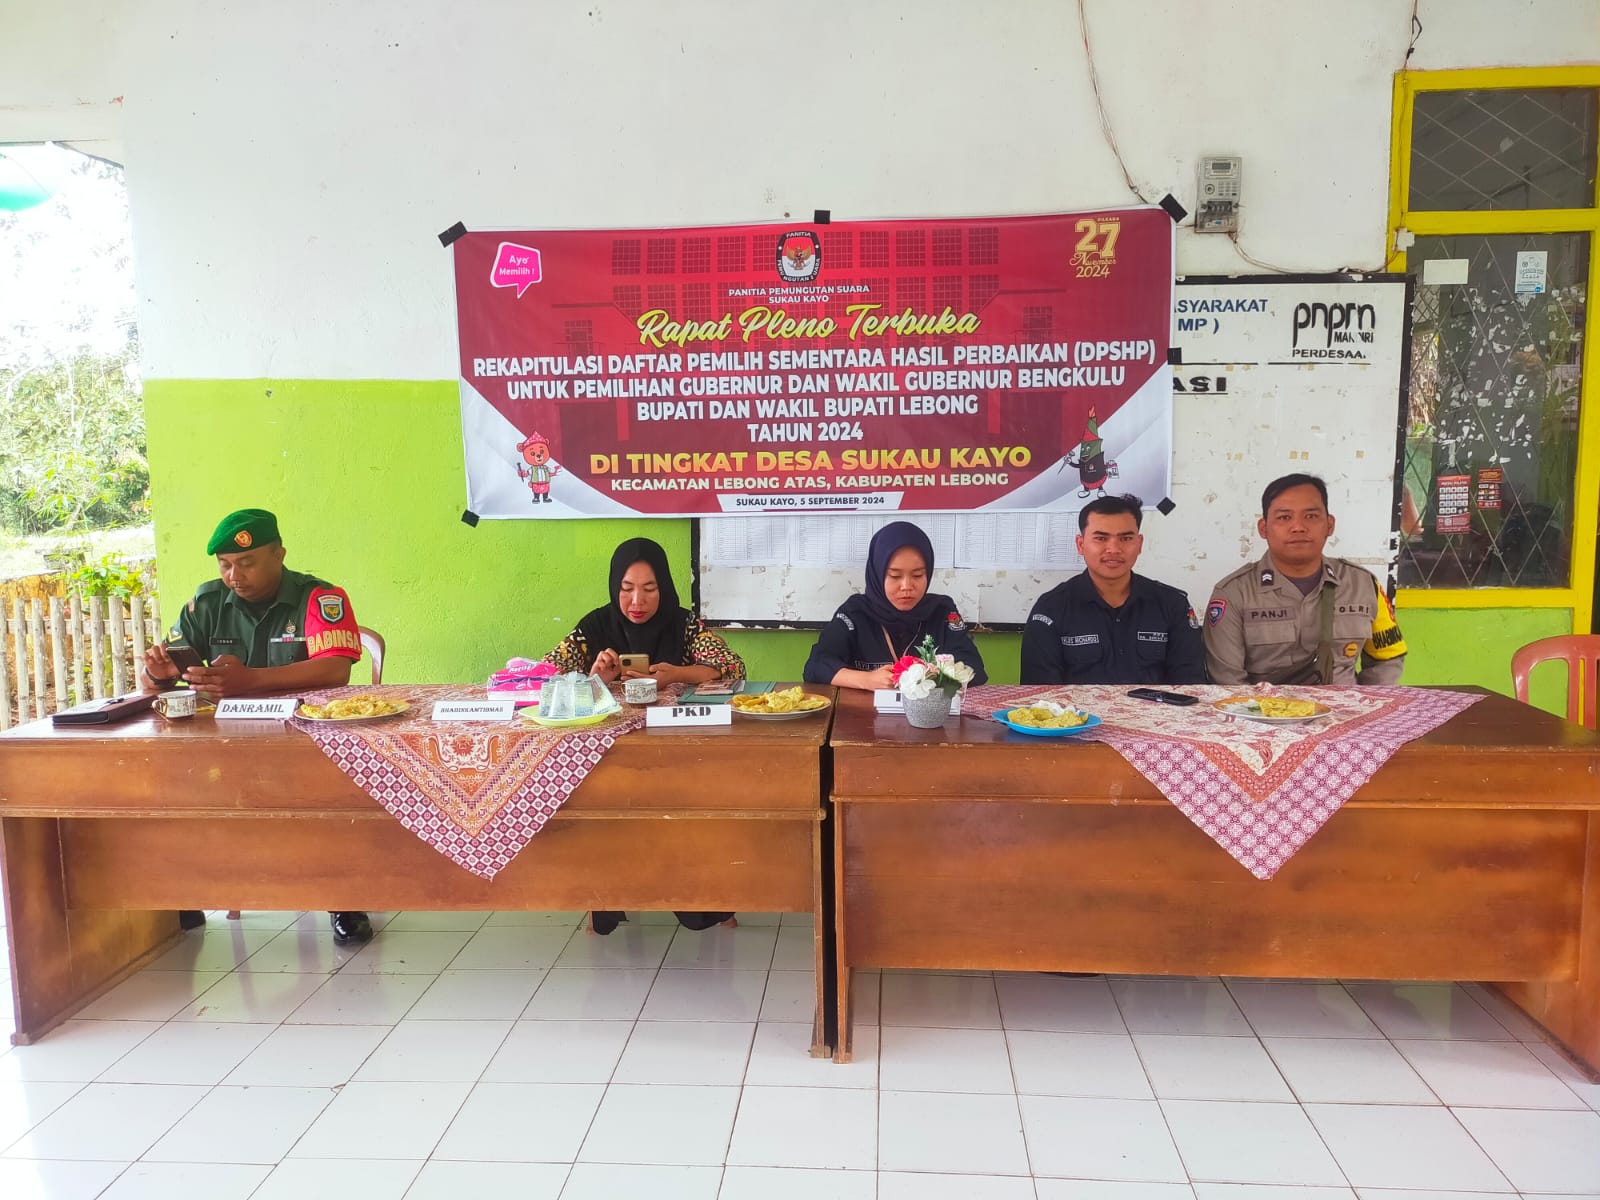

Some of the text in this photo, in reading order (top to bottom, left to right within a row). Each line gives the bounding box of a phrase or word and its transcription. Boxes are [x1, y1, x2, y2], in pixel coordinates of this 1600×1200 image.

[1075, 218, 1120, 259] 27
[509, 255, 529, 266] Ayo
[499, 267, 530, 276] Memilih
[1076, 264, 1111, 279] 2024
[728, 285, 870, 296] PANITIA PEMUNGUTAN SUARA
[769, 295, 830, 304] SUKAU KAYO
[1174, 299, 1268, 313] SYARAKAT
[636, 304, 982, 348] Rapat Pleno Terbuka
[473, 339, 1156, 377] REKAPITULASI DAFTAR PEMILIH SEMENTARA HASIL PERBAIKAN (DPSHP)
[1292, 349, 1367, 359] PERDESAA
[507, 366, 1126, 400] UNTUK PEMILIHAN GUBERNUR DAN WAKIL GUBERNUR BENGKULU
[636, 394, 979, 421] BUPATI DAN WAKIL BUPATI LEBONG
[747, 422, 864, 443] TAHUN 2024
[590, 446, 1032, 475] DI TINGKAT DESA SUKAU KAYO
[611, 472, 1009, 492] KECAMATAN LEBONG ATAS, KABUPATEN LEBONG
[736, 496, 885, 507] SUKAU KAYO, 5 SEPTEMBER 2024
[1251, 610, 1288, 619] PANJI
[1333, 606, 1369, 614] OLRI
[307, 629, 361, 656] BABINSA
[221, 703, 285, 713] DANRAMIL
[672, 705, 712, 718] PKD
